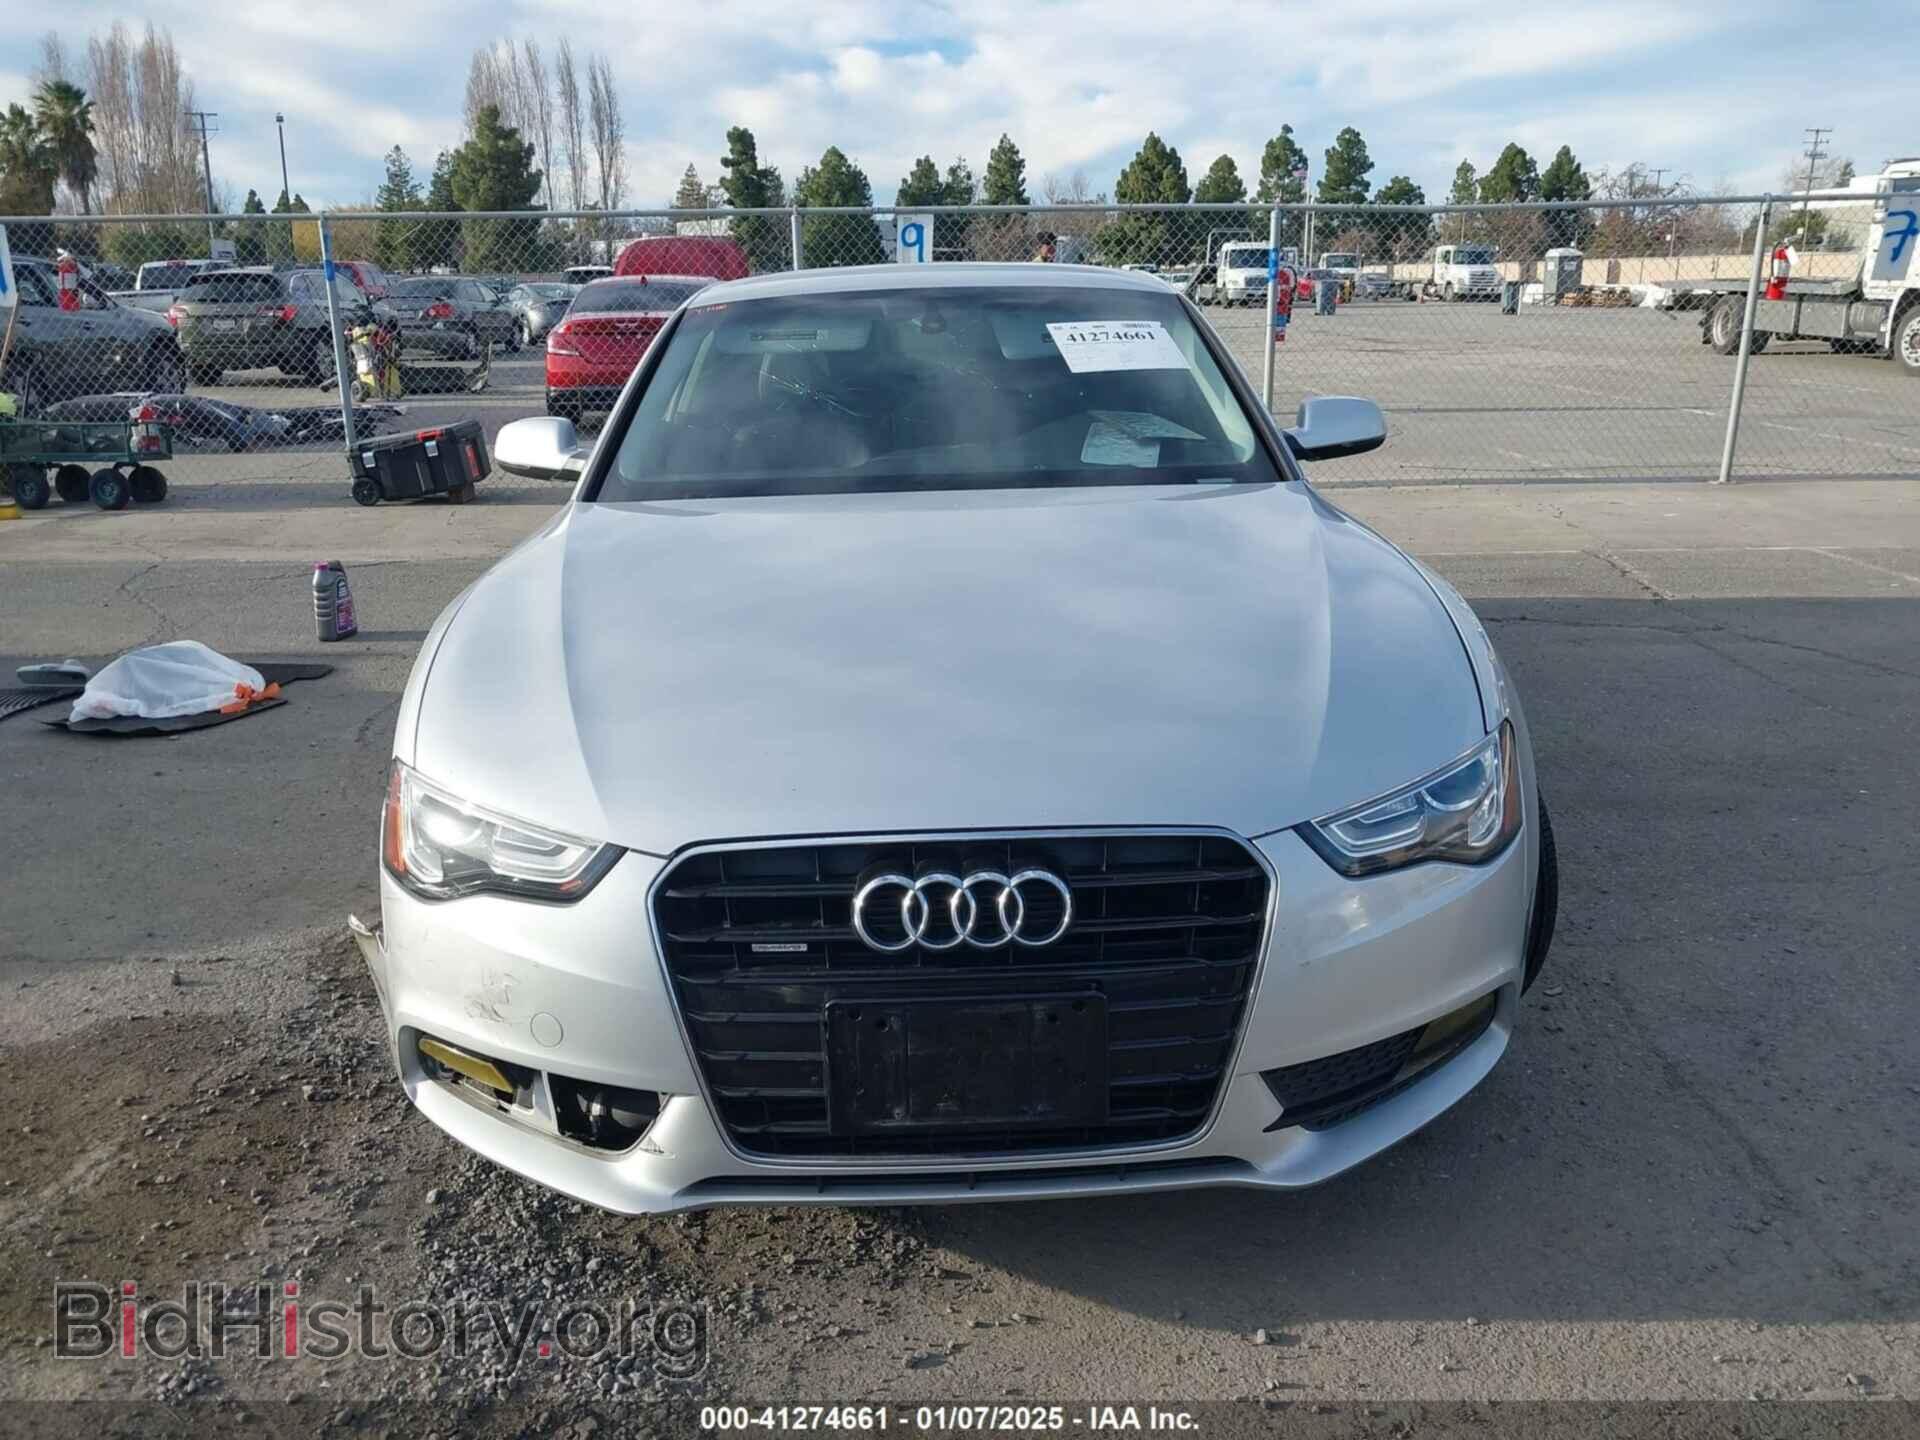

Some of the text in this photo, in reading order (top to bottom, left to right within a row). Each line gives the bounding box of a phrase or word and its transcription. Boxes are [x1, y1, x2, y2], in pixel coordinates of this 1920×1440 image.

[901, 222, 924, 263] 9
[1884, 210, 1919, 262] 7
[1066, 331, 1155, 343] 41274661
